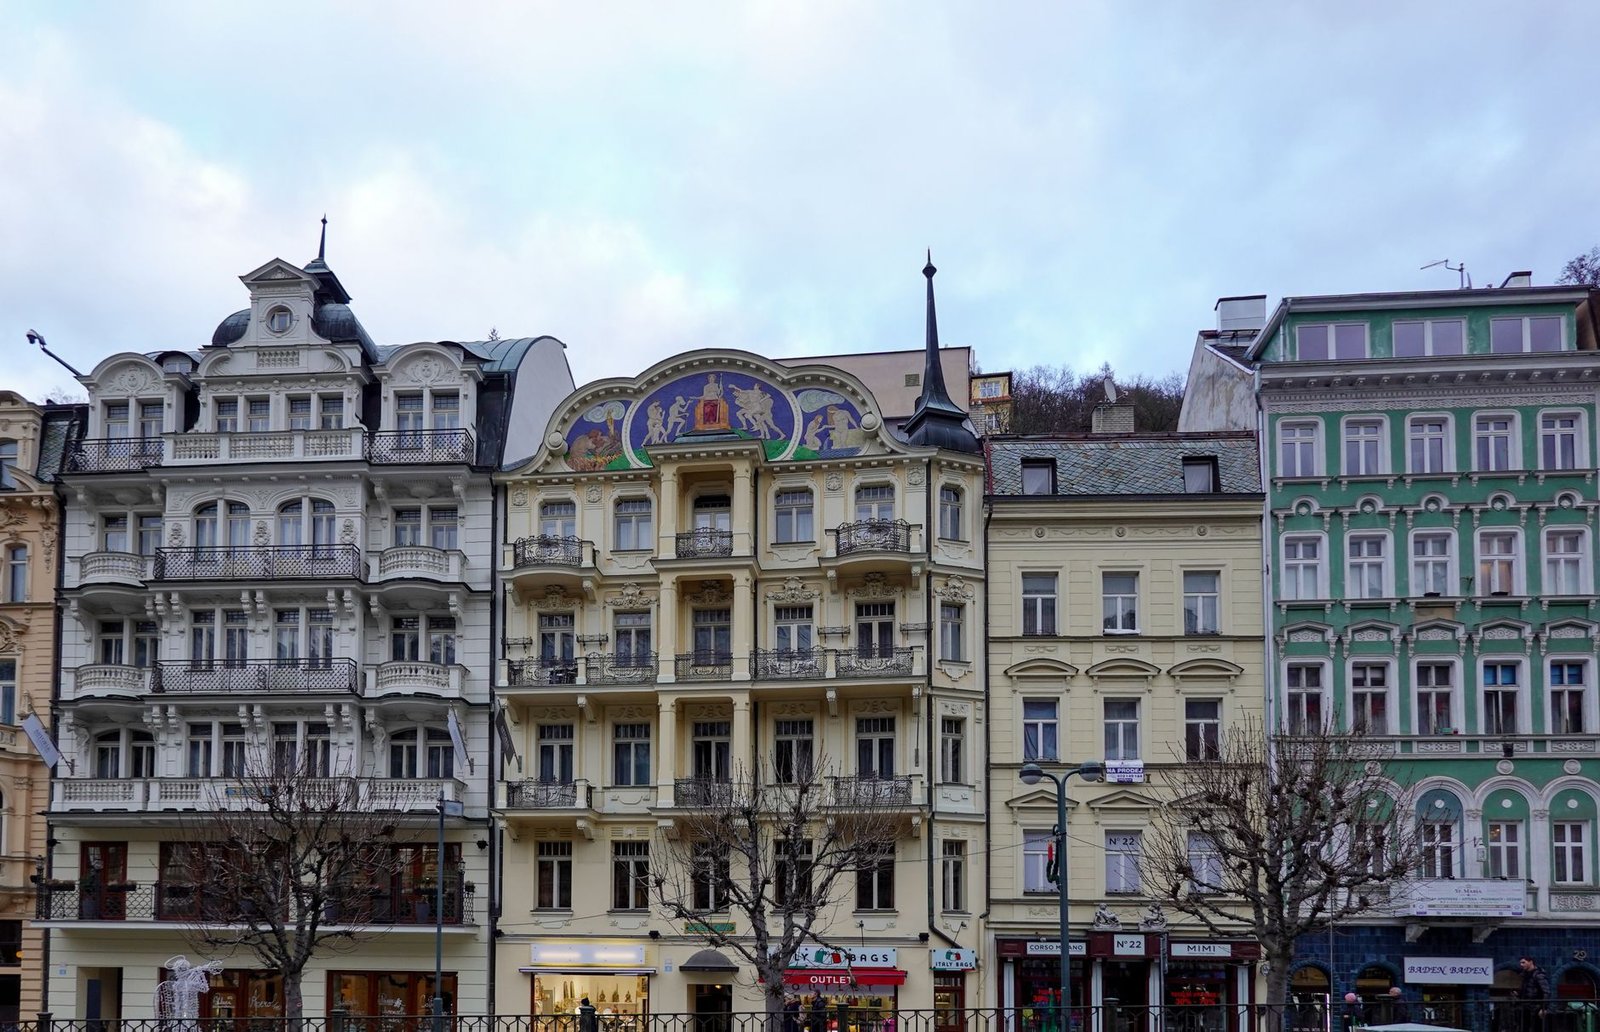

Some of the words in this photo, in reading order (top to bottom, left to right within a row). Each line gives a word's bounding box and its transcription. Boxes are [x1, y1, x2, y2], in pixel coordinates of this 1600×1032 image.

[1122, 837, 1135, 846] 22
[1129, 940, 1142, 949] 22
[850, 954, 889, 963] BAGS
[1408, 965, 1447, 975] BADEN
[1449, 966, 1489, 976] BADEN
[809, 975, 852, 984] OUTLET
